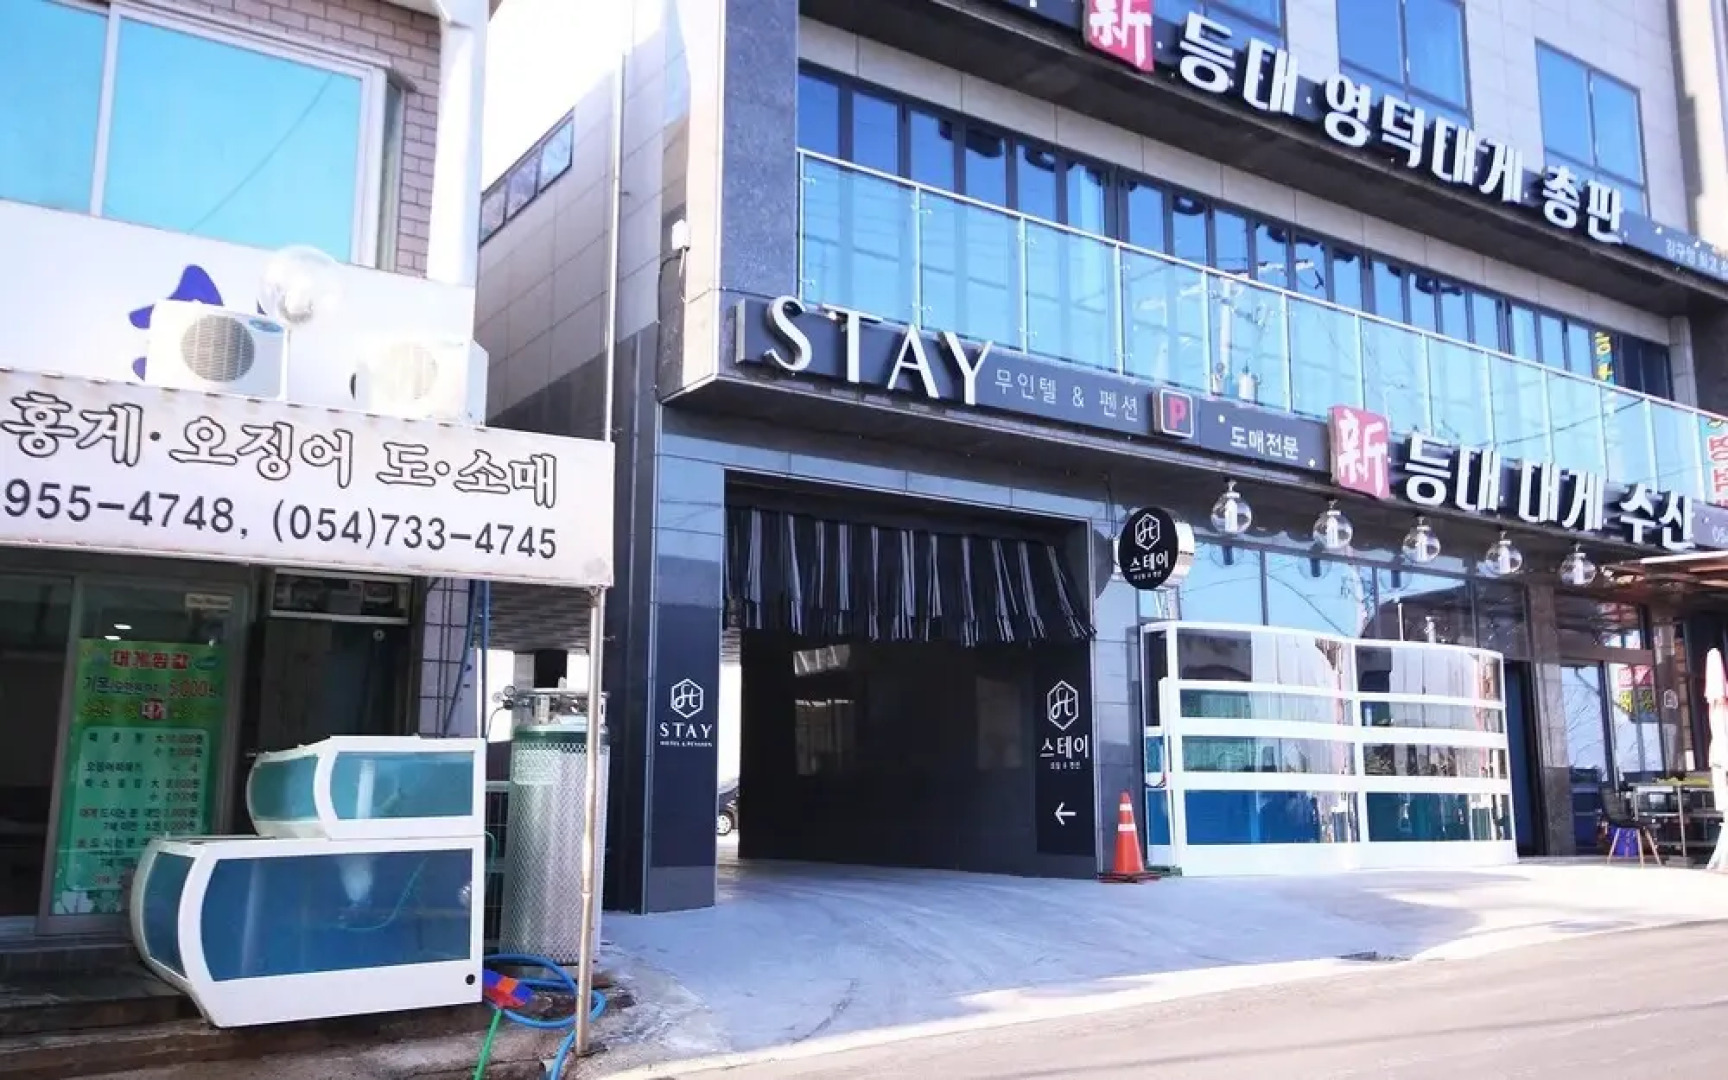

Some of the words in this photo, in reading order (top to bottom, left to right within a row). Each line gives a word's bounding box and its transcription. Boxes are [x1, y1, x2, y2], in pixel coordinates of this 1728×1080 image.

[1179, 11, 1299, 116] 등대
[1325, 76, 1523, 204] 영덕대게
[1542, 164, 1625, 244] 총판
[764, 296, 993, 405] STAY
[995, 368, 1057, 402] 무인텔
[1071, 387, 1084, 407] &
[1099, 389, 1138, 422] 펜션
[1168, 398, 1186, 429] P
[1230, 426, 1299, 460] 도매전문
[1336, 410, 1389, 497] 新
[1405, 430, 1501, 513] 등대
[1519, 457, 1602, 532] 대게
[1619, 483, 1695, 548] 수산
[272, 499, 556, 560] (054)733-4745
[1130, 550, 1169, 571] 스테이
[659, 721, 713, 739] STAY
[1039, 733, 1090, 760] 스테이
